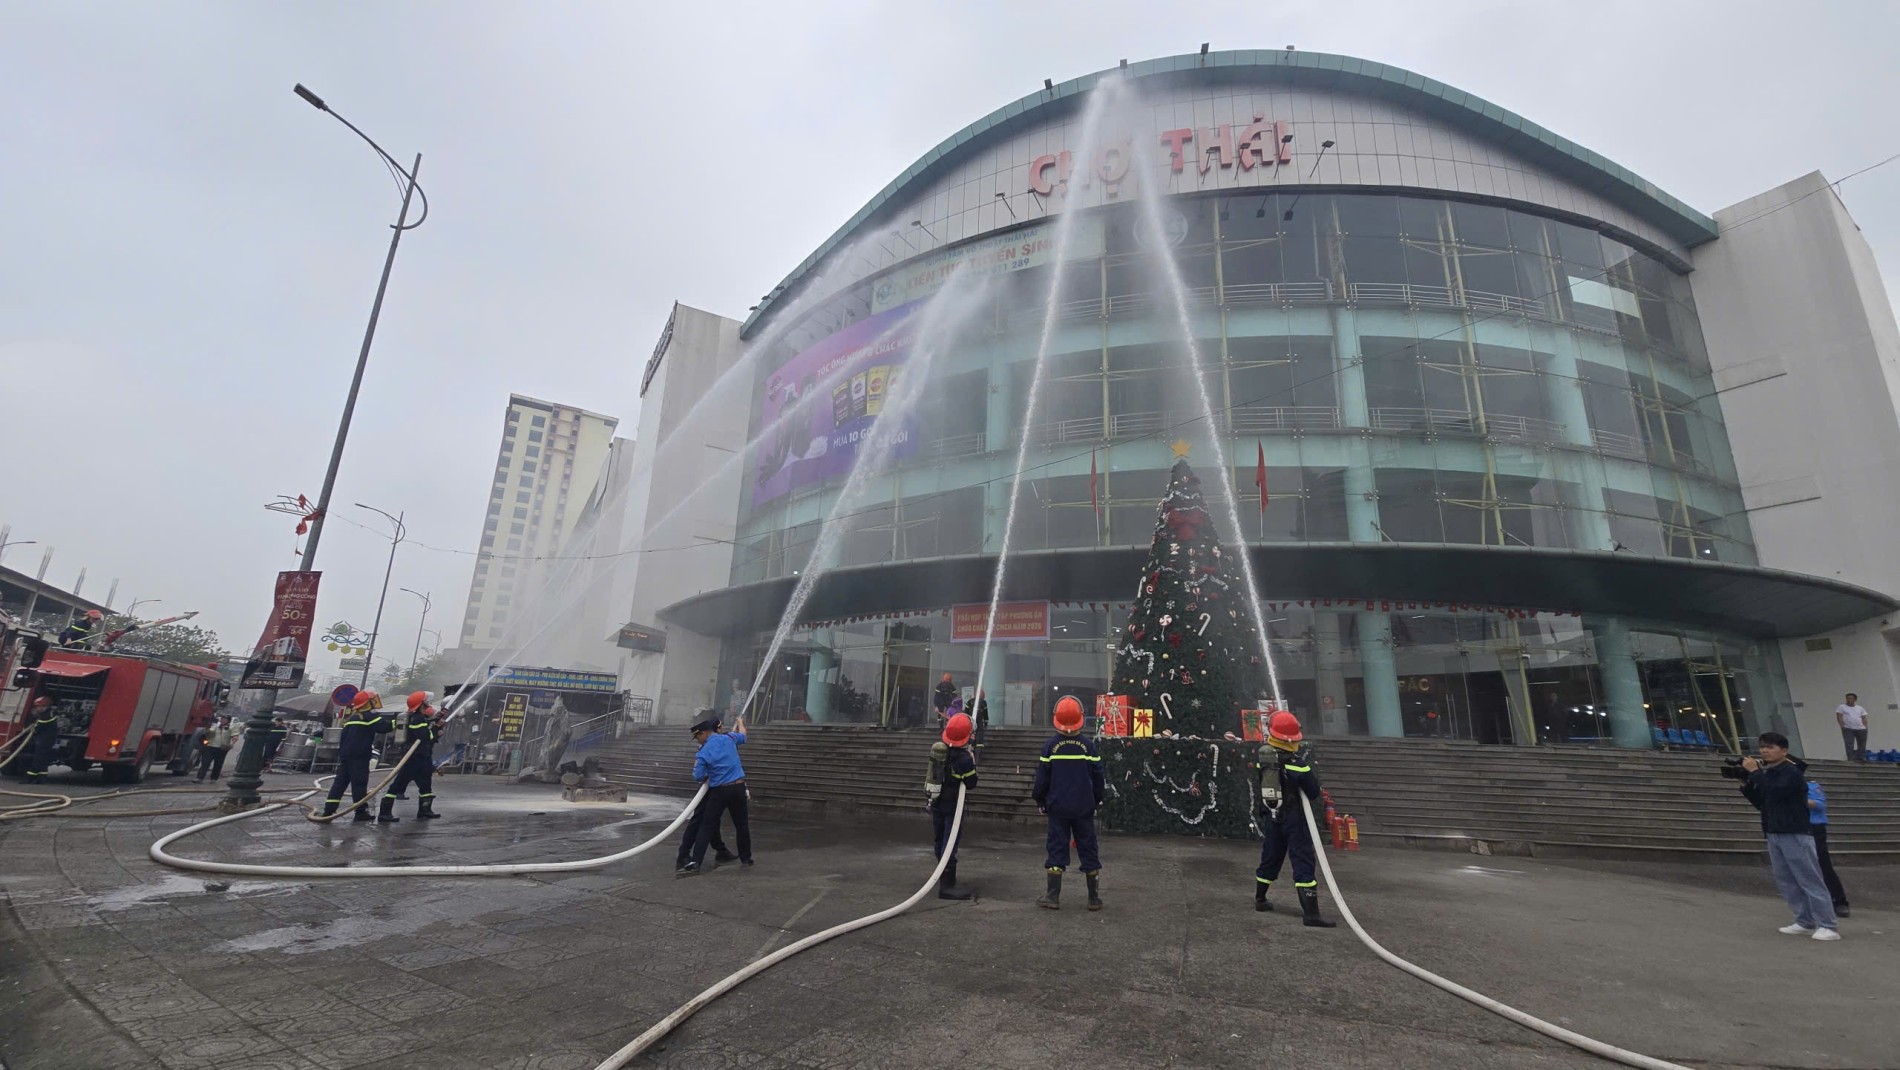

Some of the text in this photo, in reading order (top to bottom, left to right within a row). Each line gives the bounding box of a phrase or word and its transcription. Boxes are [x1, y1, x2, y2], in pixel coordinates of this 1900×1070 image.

[1161, 113, 1292, 175] THÁI
[1012, 257, 1030, 271] 289
[833, 434, 848, 449] MUA
[848, 430, 859, 443] 10
